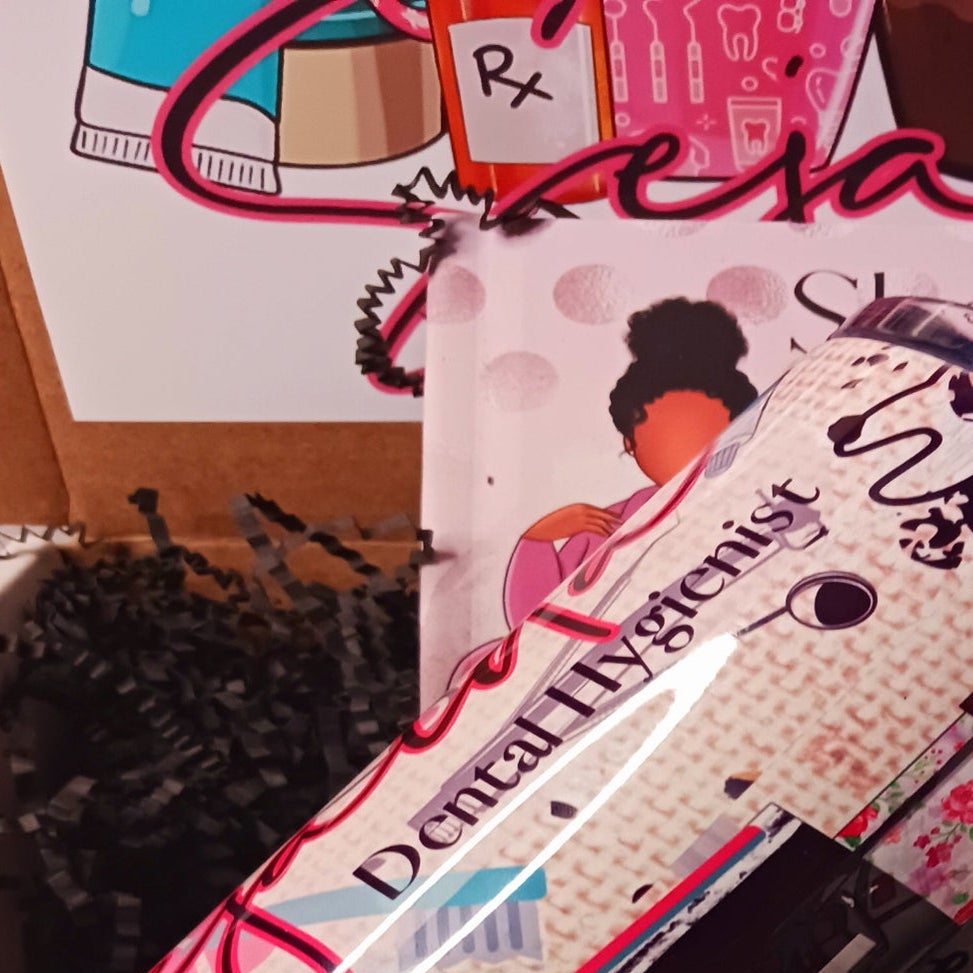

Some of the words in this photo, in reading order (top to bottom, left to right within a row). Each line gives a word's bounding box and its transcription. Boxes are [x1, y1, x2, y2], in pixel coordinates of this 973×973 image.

[473, 44, 553, 108] Rx
[352, 717, 564, 900] Dental
[545, 477, 821, 721] Hygienist
